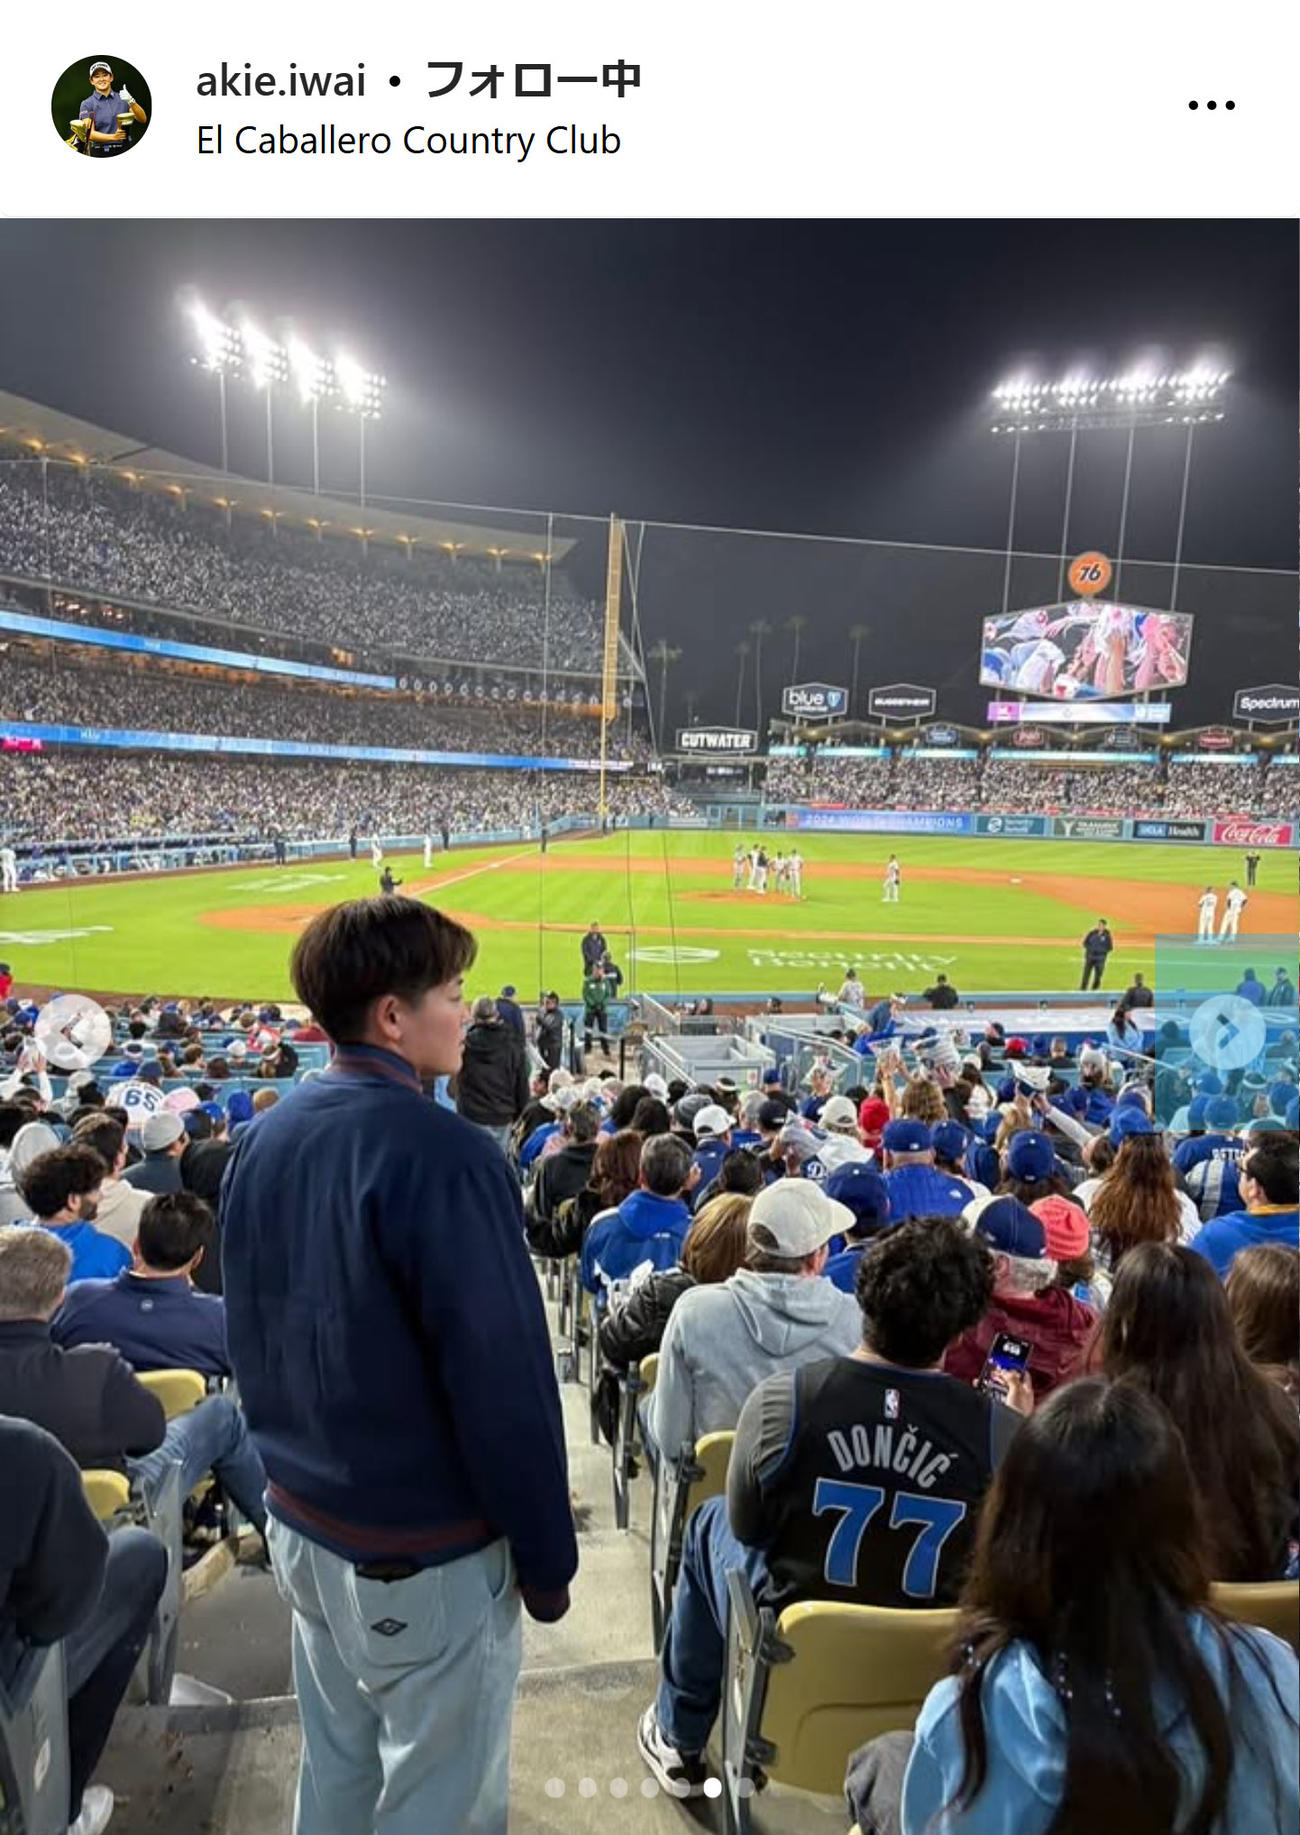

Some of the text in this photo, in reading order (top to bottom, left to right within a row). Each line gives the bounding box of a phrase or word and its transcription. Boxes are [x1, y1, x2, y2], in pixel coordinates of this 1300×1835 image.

[1080, 563, 1102, 582] 76
[789, 688, 824, 706] blue
[681, 732, 751, 748] CUTWATER
[124, 1089, 159, 1112] 65
[827, 1424, 959, 1488] DONČIĆ
[812, 1477, 967, 1598] 77
